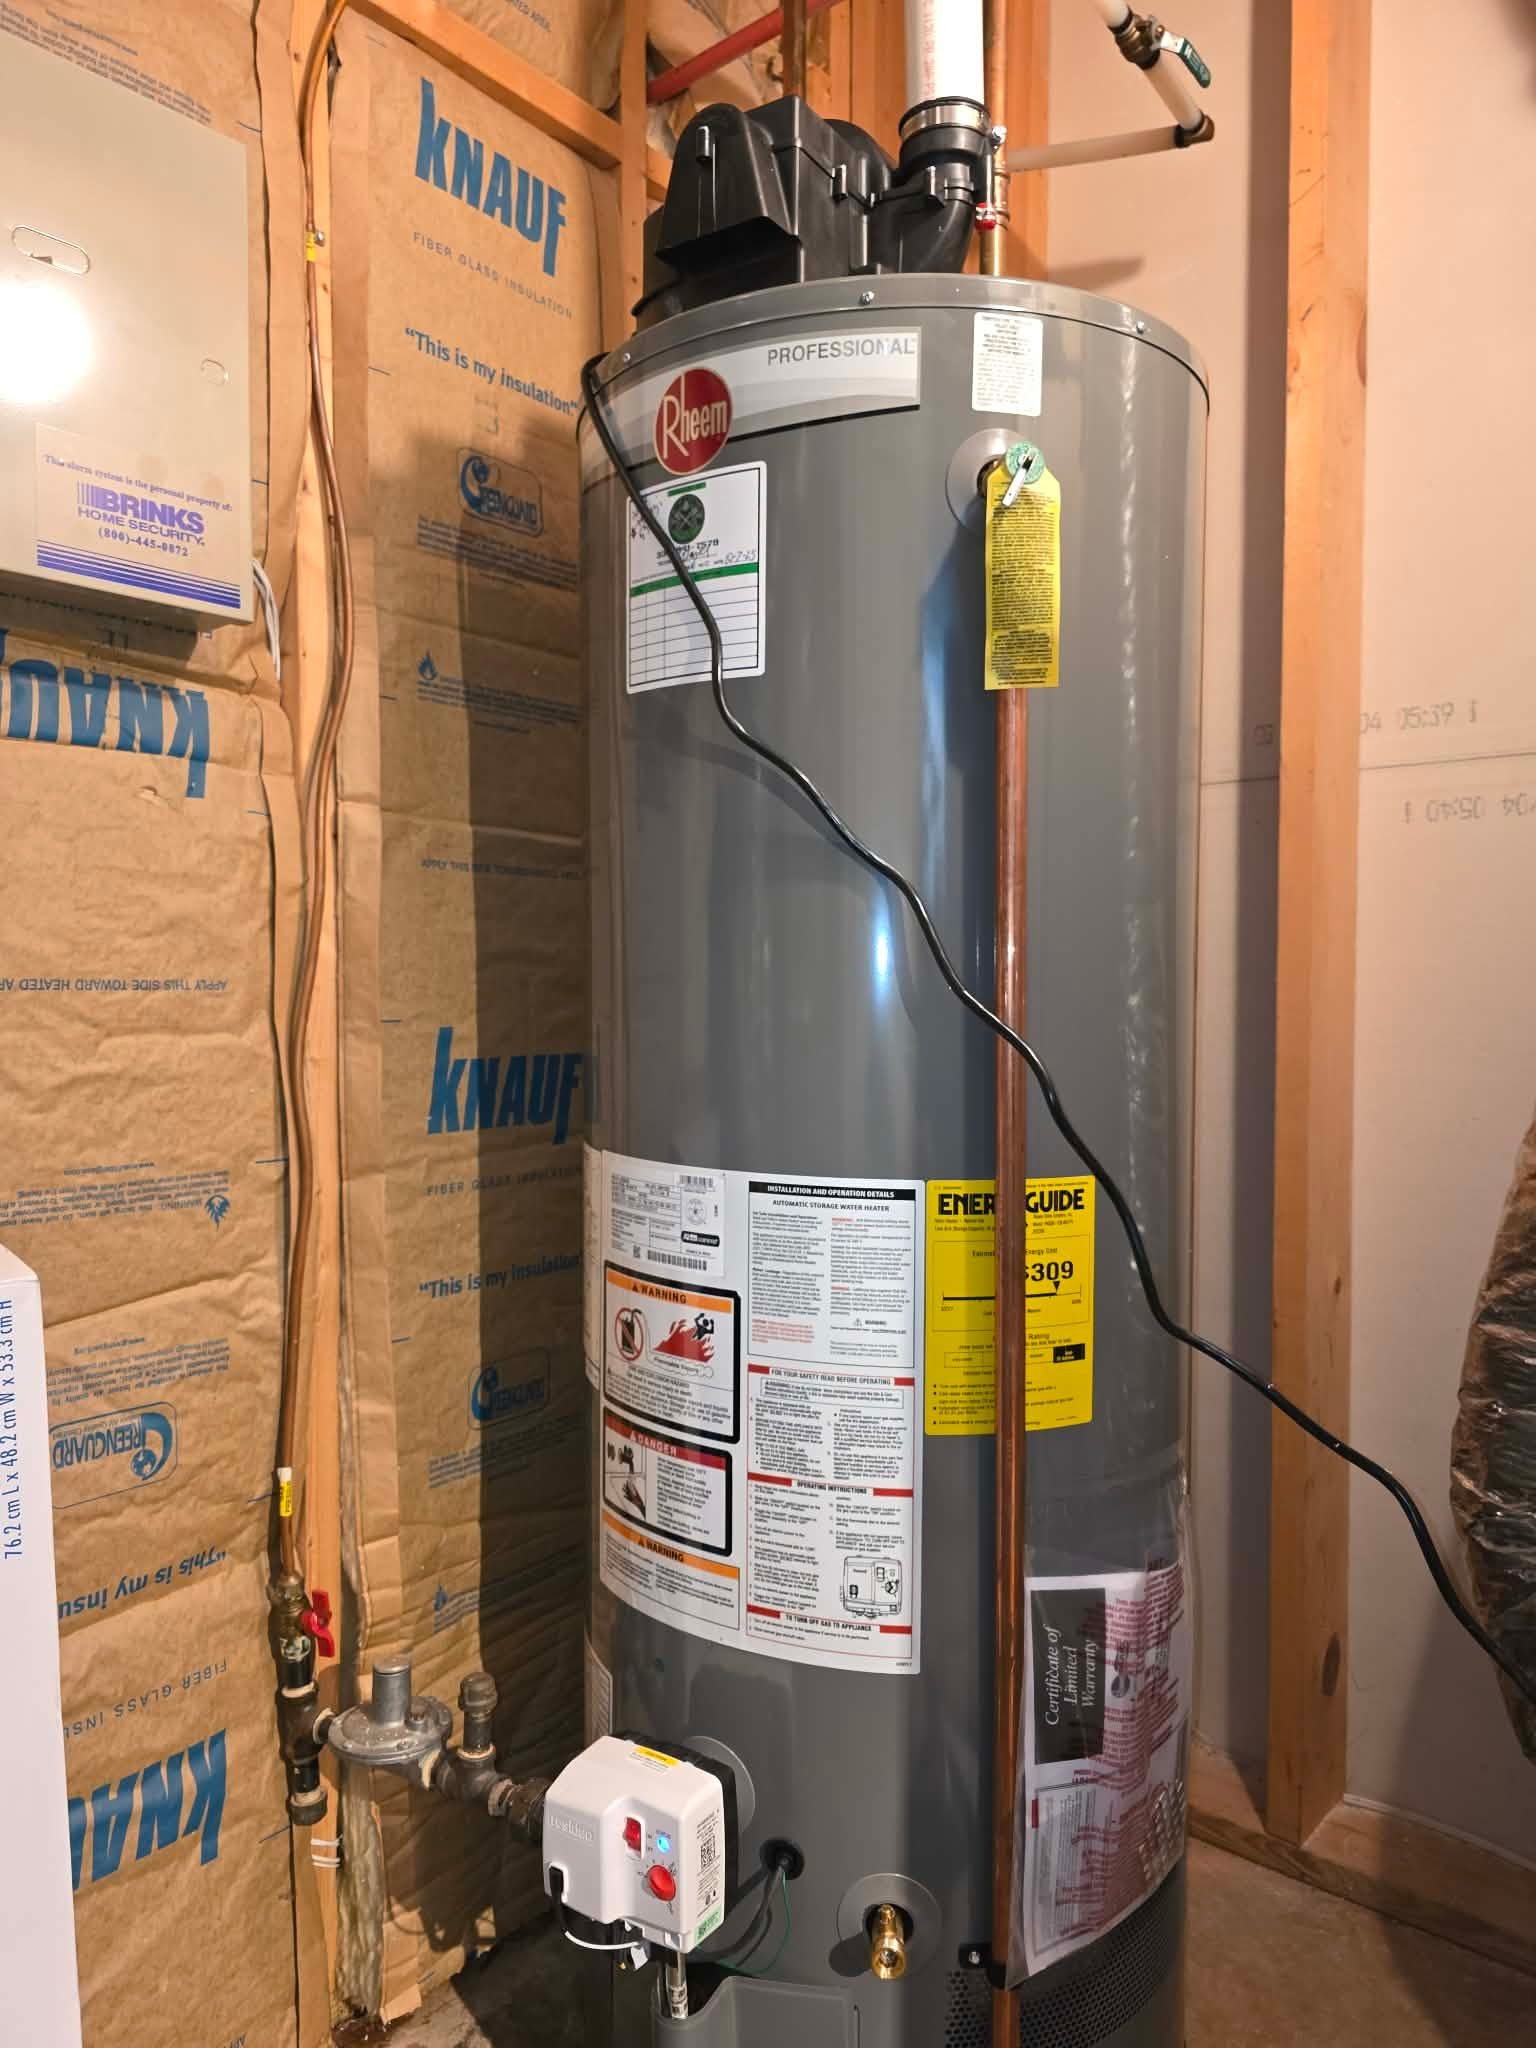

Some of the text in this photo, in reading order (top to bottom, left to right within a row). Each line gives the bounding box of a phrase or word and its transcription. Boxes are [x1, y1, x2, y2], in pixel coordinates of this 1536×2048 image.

[415, 76, 567, 277] KNAUF
[413, 231, 453, 257] FIBER
[458, 254, 499, 283] GLASS
[767, 338, 917, 366] PROFESSIONAL
[455, 346, 469, 370] is
[473, 358, 496, 384] my
[661, 371, 729, 459] Rheem
[78, 506, 126, 527] HOME
[95, 485, 205, 535] BRINKS
[18, 978, 70, 992] HEATED
[75, 978, 130, 991] TOWARD
[132, 978, 161, 991] SIDE
[164, 978, 192, 991] THIS
[194, 978, 229, 991] APPLY
[427, 1026, 584, 1146] KNAUF
[767, 1184, 895, 1199] INSTALLATION AND OPERATION DETAILS
[772, 1199, 890, 1212] AUTOMATIC STORAGE WATER HEATER
[467, 1272, 481, 1291] is
[640, 1284, 688, 1305] WARNING
[0, 1315, 14, 1335] cm
[0, 1339, 14, 1373] 53.3
[2, 1377, 16, 1387] x
[771, 1369, 783, 1378] FOR
[783, 1370, 798, 1379] YOUR
[799, 1372, 819, 1381] SAFETY
[836, 1375, 858, 1384] BEFORE
[858, 1377, 891, 1386] OPERATING
[0, 1392, 15, 1406] W
[1, 1409, 17, 1430] cm
[0, 1433, 18, 1468] 48.2
[638, 1434, 678, 1457] DANGER
[6, 1471, 19, 1483] x
[797, 1480, 868, 1495] OPERATING INSTRUCTIONS
[3, 1487, 20, 1496] L
[4, 1498, 21, 1520] cm
[3, 1523, 23, 1560] 76.2
[646, 1538, 685, 1563] WARNING
[115, 1569, 149, 1600] my
[155, 1563, 173, 1586] is
[841, 1622, 872, 1632] APPLIANCE
[181, 1656, 229, 1691] FIBER
[1042, 1624, 1063, 1726] Certificate of
[1062, 1645, 1079, 1705] Limited
[1080, 1639, 1098, 1707] Warranty
[113, 1683, 173, 1719] GLASS
